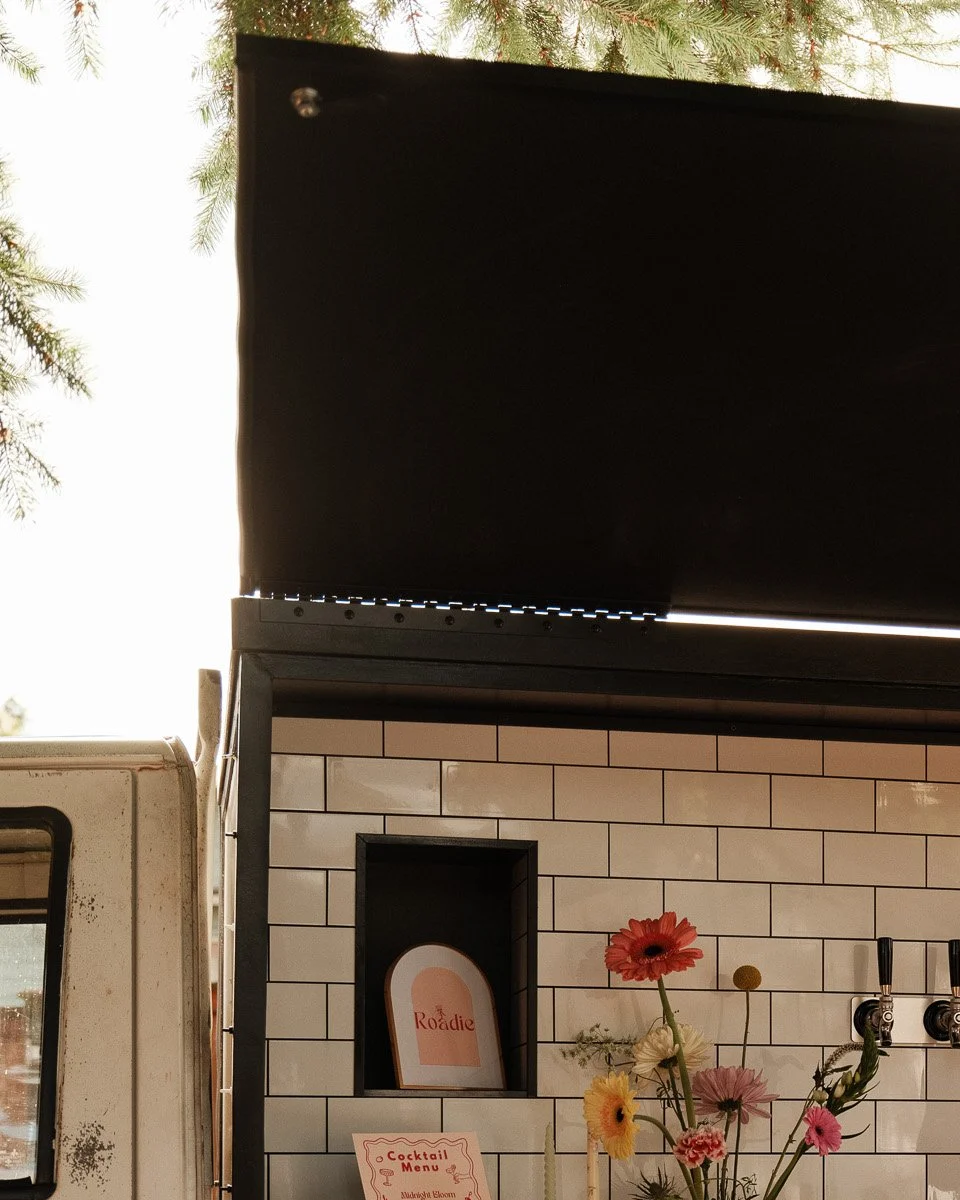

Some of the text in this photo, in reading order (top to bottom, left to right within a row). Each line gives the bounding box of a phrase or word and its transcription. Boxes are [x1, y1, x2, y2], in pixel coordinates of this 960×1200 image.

[414, 1011, 475, 1032] Roadie
[387, 1150, 448, 1161] Cocktail
[401, 1161, 439, 1172] Menu
[400, 1190, 456, 1200] Midnight Bloom
